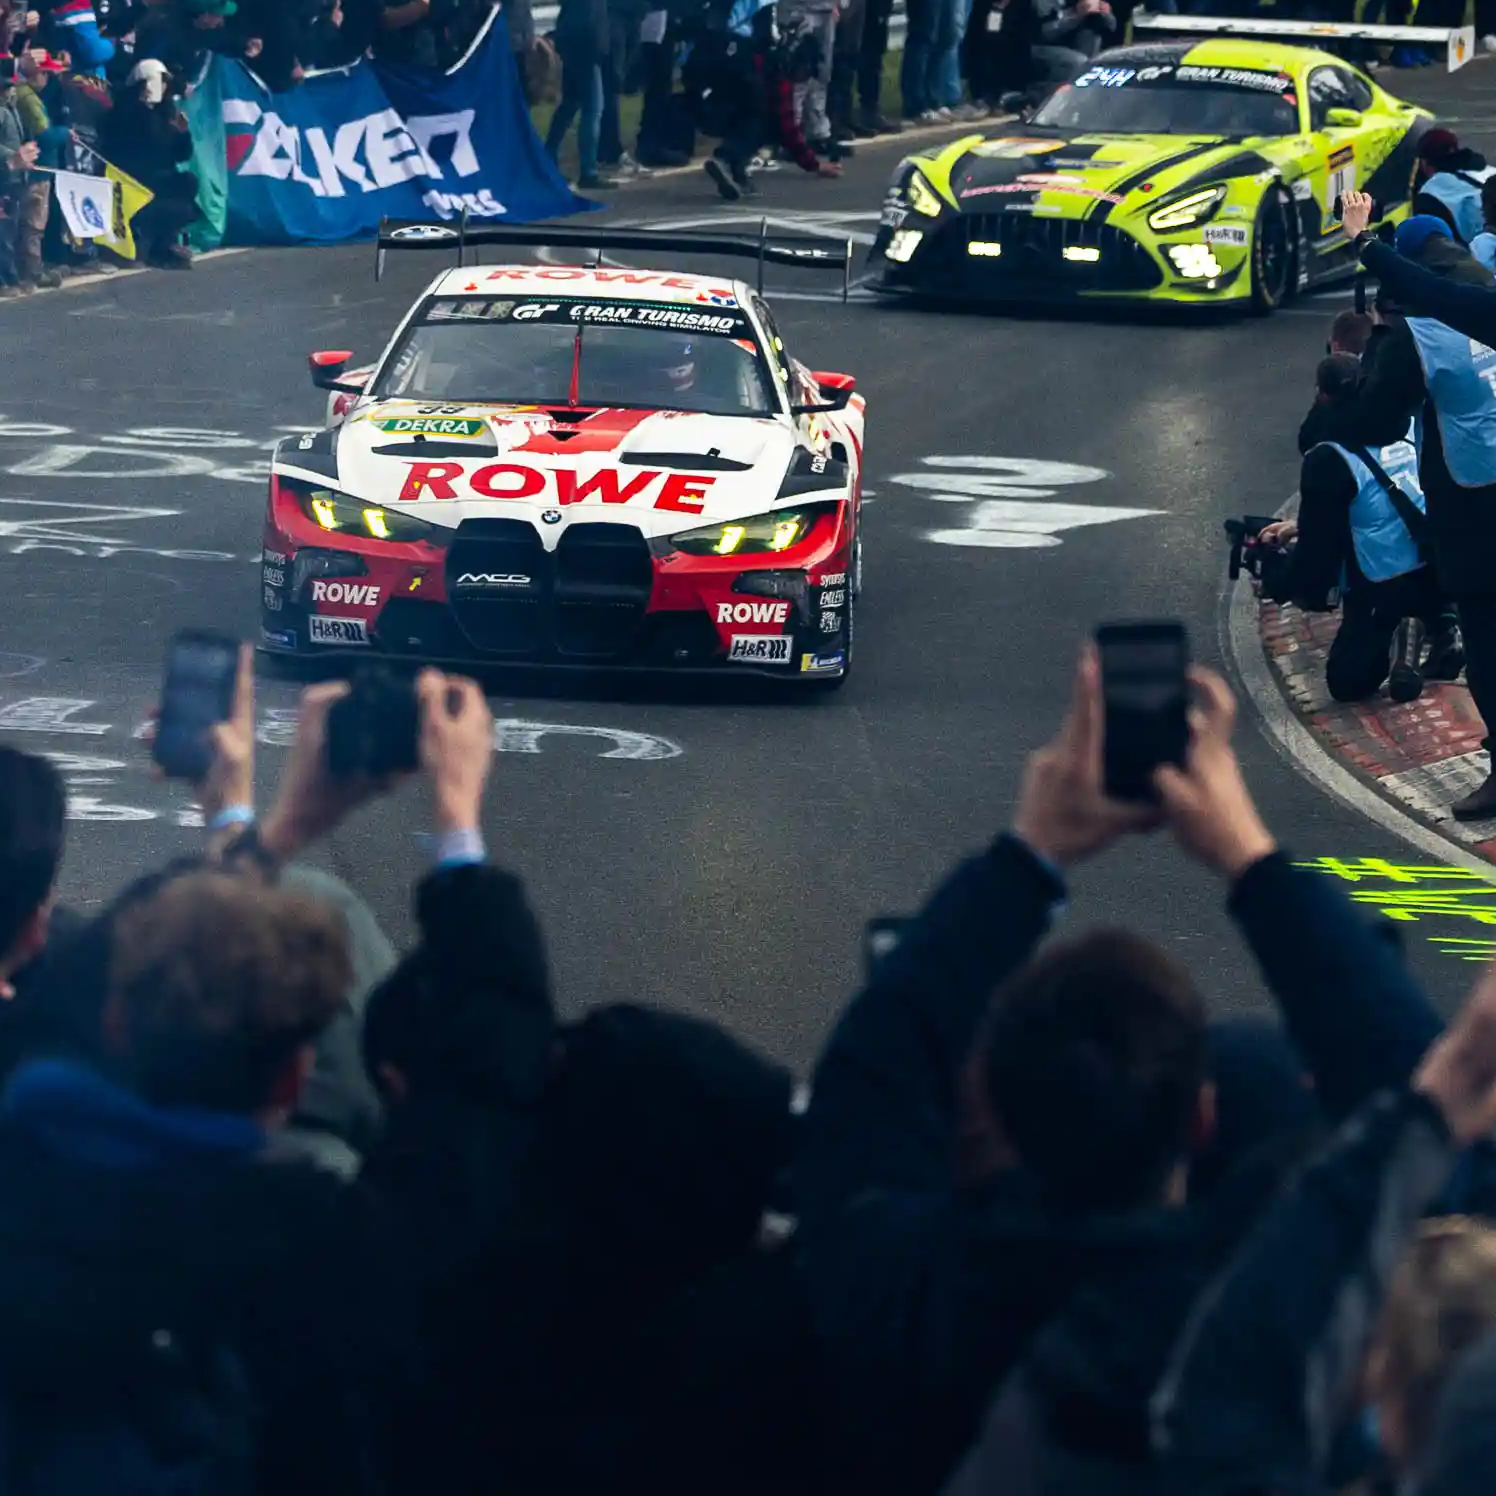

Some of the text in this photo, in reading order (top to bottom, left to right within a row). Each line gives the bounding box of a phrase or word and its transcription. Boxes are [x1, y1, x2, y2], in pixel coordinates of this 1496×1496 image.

[1175, 65, 1218, 81] GRAN
[1222, 66, 1290, 90] TURISMO
[486, 268, 696, 290] ROWE
[569, 304, 633, 320] GRAN
[636, 307, 736, 330] TURISMO
[393, 418, 472, 435] DEKRA
[398, 460, 717, 515] ROWE
[312, 580, 381, 606] ROWE
[716, 602, 789, 624] ROWE
[312, 620, 343, 639] H&R
[732, 639, 767, 657] H&R
